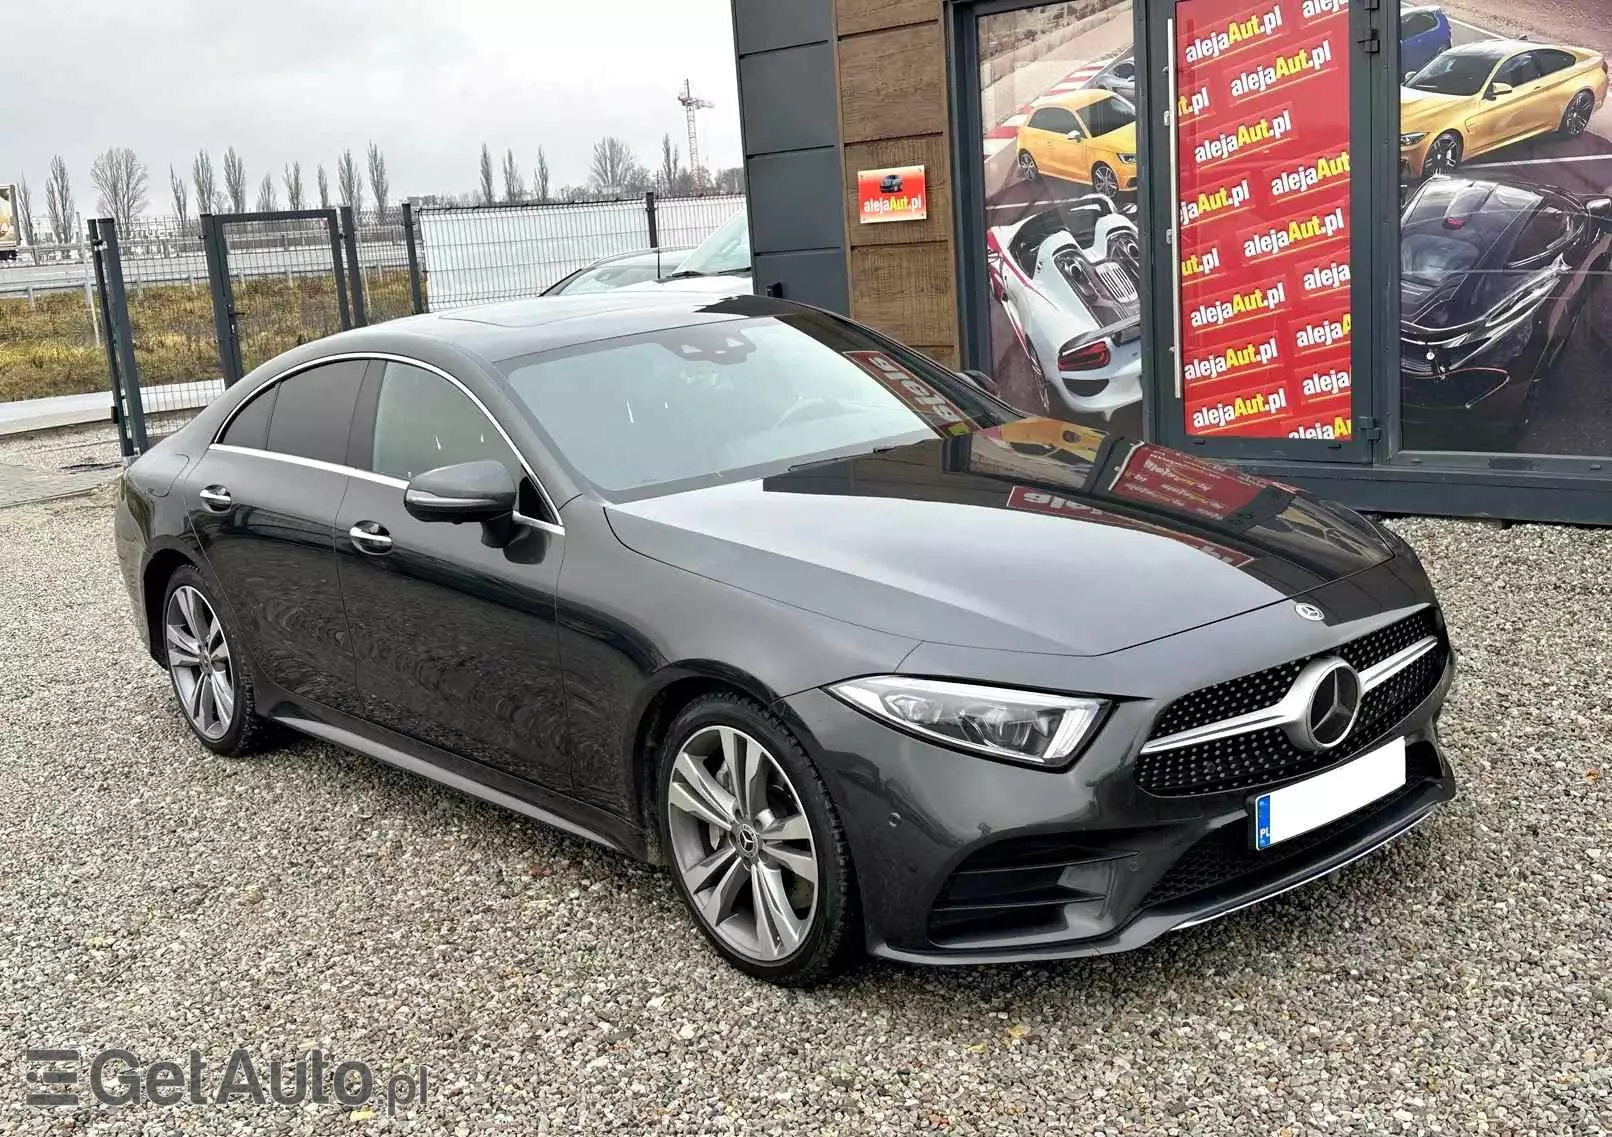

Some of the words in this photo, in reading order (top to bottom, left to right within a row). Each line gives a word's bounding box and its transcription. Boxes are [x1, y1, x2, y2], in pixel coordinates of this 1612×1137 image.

[1185, 5, 1284, 63] alejaAut.pl
[1231, 40, 1332, 97] alejaAut.pl
[1195, 110, 1292, 163] alejaAut.pl
[1271, 152, 1350, 196] alejaAut
[864, 194, 921, 213] alejaAut.pl
[1244, 208, 1344, 257] alejaAut.pl
[1303, 262, 1350, 290] aleja
[1190, 282, 1285, 327] alejaAut.pl
[1184, 338, 1278, 380] alejaAut.pl
[1303, 369, 1350, 396] aleja
[1193, 388, 1287, 428] alejaAut.pl
[1259, 828, 1270, 839] PL
